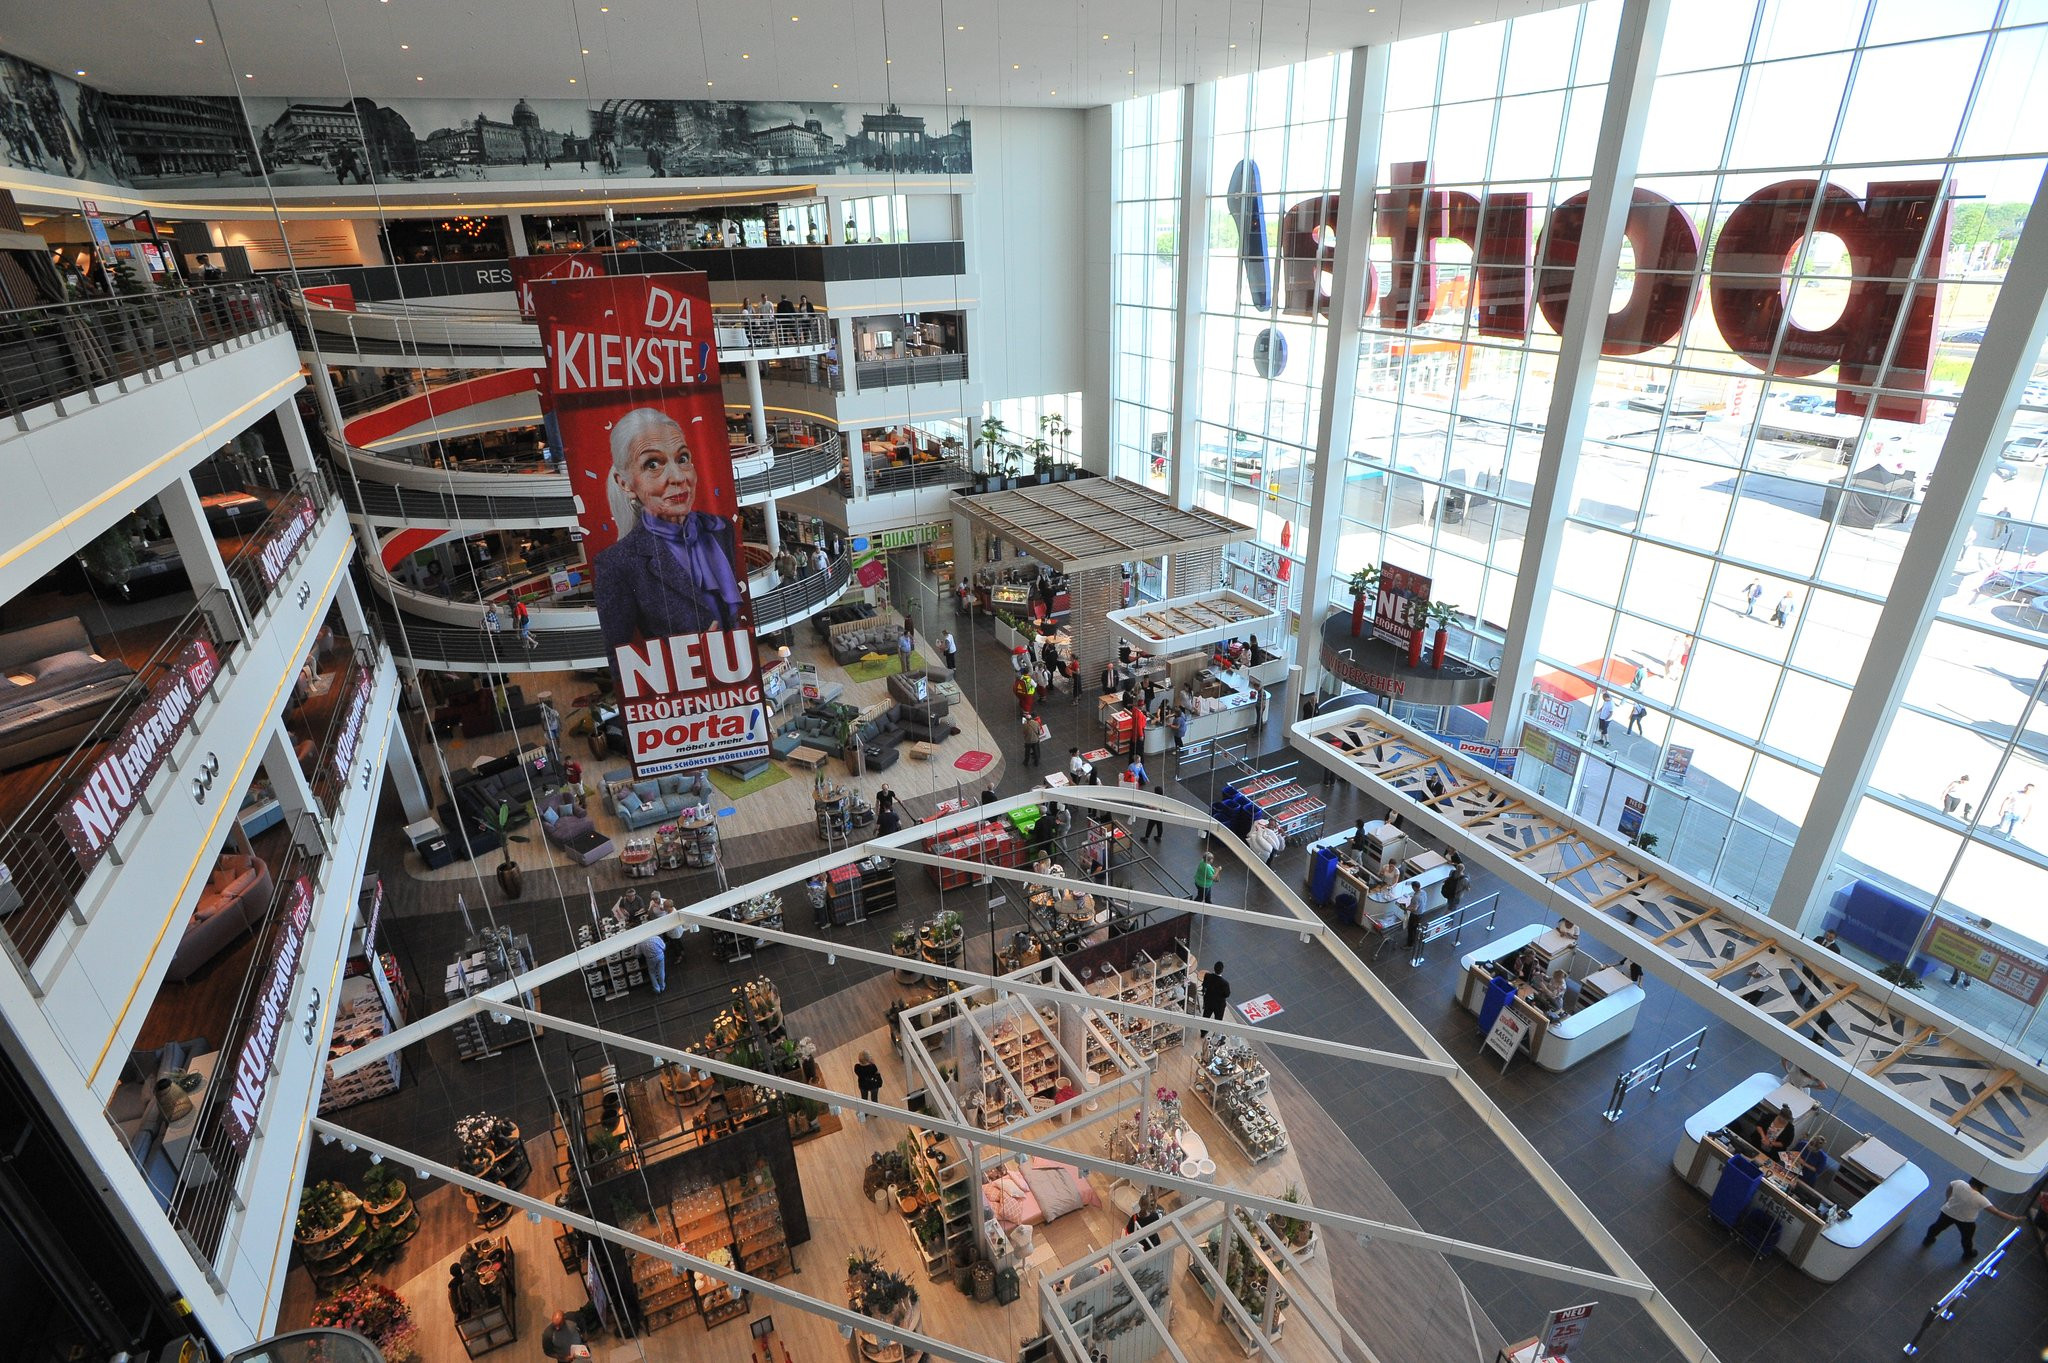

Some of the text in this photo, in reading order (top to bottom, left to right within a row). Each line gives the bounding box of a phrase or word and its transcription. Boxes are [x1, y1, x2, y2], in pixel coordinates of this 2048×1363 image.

[645, 286, 692, 336] DA
[557, 330, 710, 389] KIEKSTE!
[883, 525, 939, 548] QUARTIER
[1375, 616, 1412, 640] ERÖFFNU
[615, 629, 753, 698] NEU
[1328, 656, 1406, 696] WIEDERSEHEN
[624, 685, 760, 722] ERÖFFNUNG
[1541, 698, 1569, 720] NEU
[637, 708, 760, 755] porta!
[676, 742, 708, 753] möbel
[717, 736, 744, 746] mehr
[1460, 743, 1495, 757] porta!
[640, 748, 767, 775] BERLINS SCHÖNSTES MÖBELHAUS!
[1629, 797, 1643, 809] NEU
[1494, 1028, 1514, 1047] KASSEN
[1562, 1307, 1586, 1319] NEU
